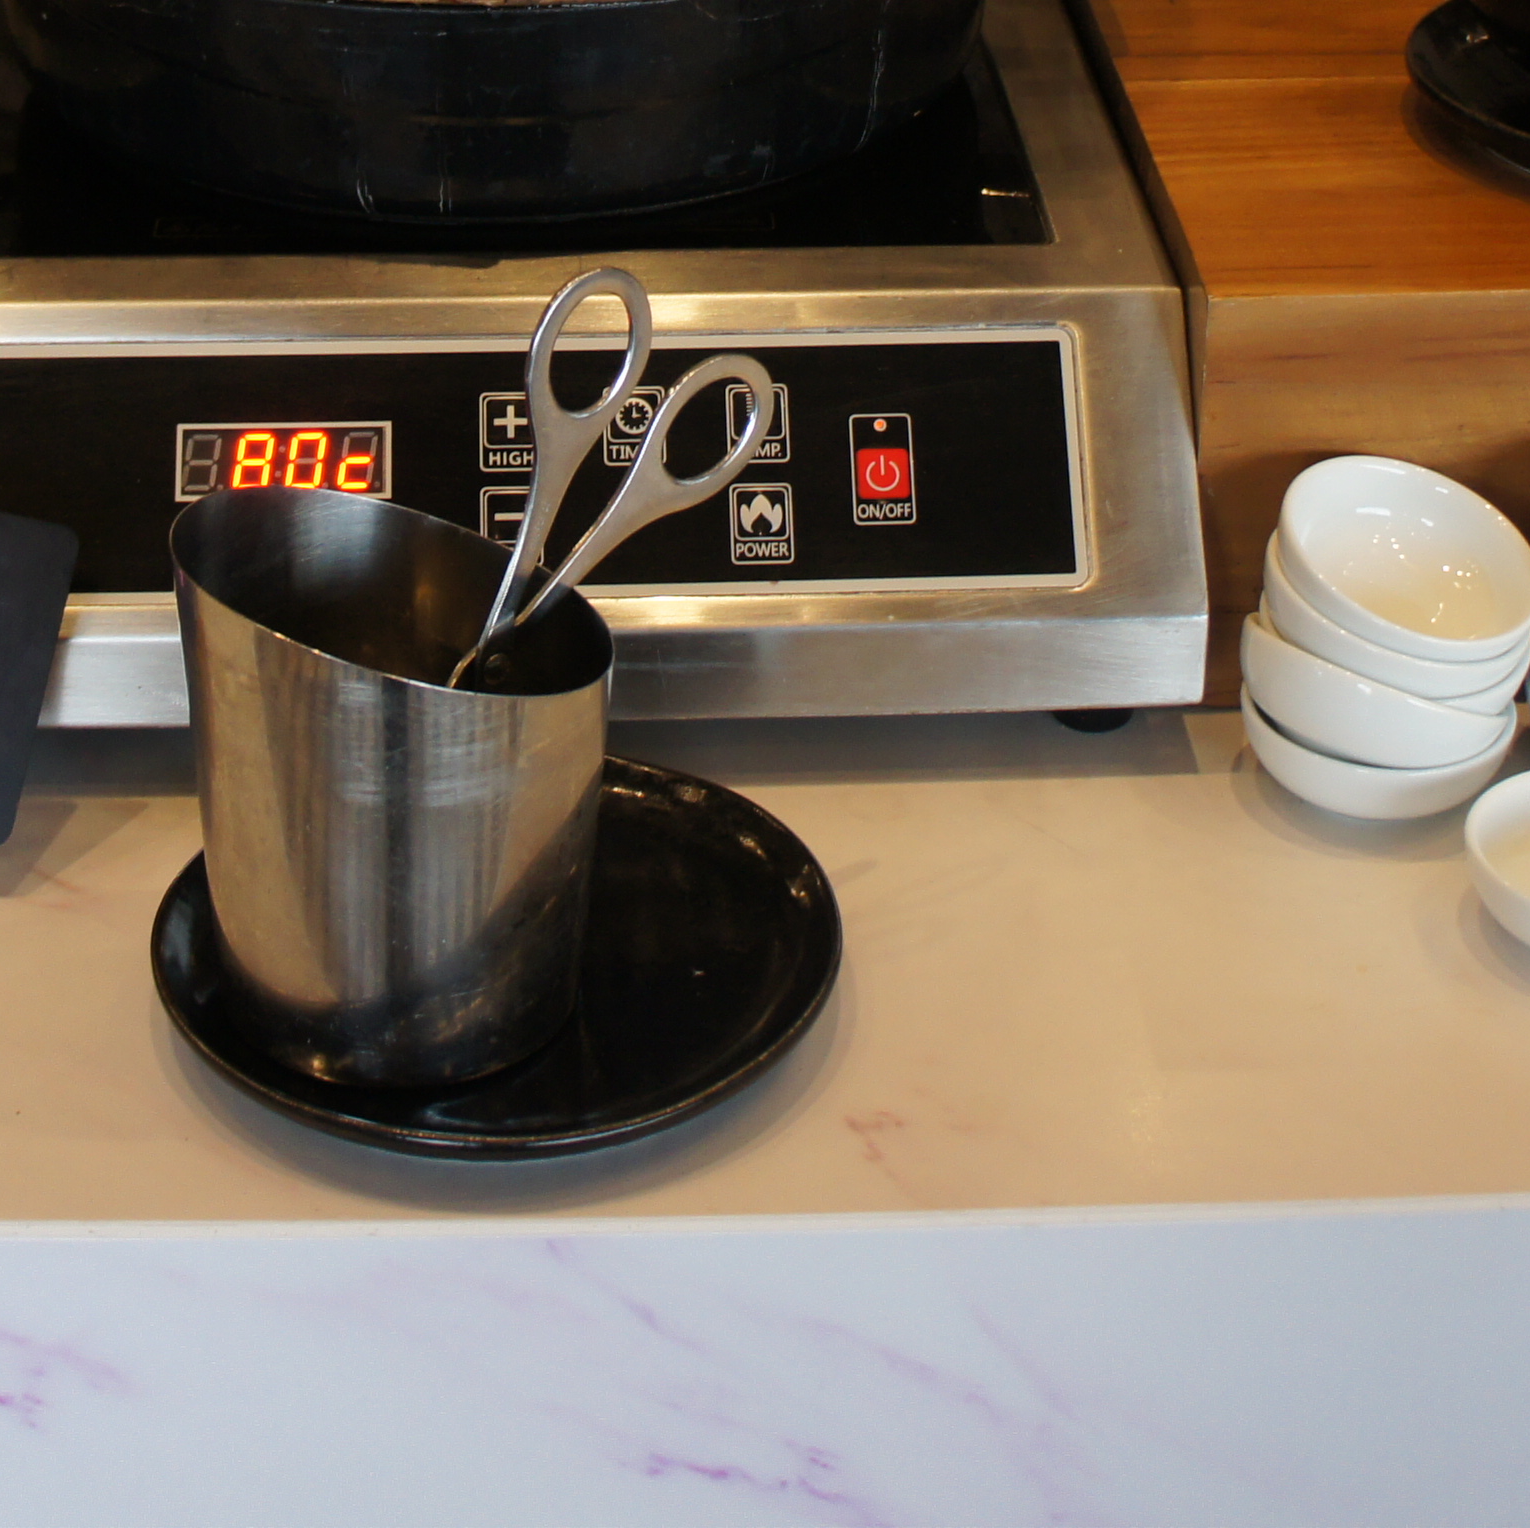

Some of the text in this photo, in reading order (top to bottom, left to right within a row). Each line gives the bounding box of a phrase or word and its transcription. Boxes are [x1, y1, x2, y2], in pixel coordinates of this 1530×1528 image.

[608, 443, 640, 461] TIM
[753, 441, 783, 458] MP.
[487, 450, 535, 467] HIGH
[857, 502, 912, 520] ON/OFF
[735, 542, 789, 558] POWER
